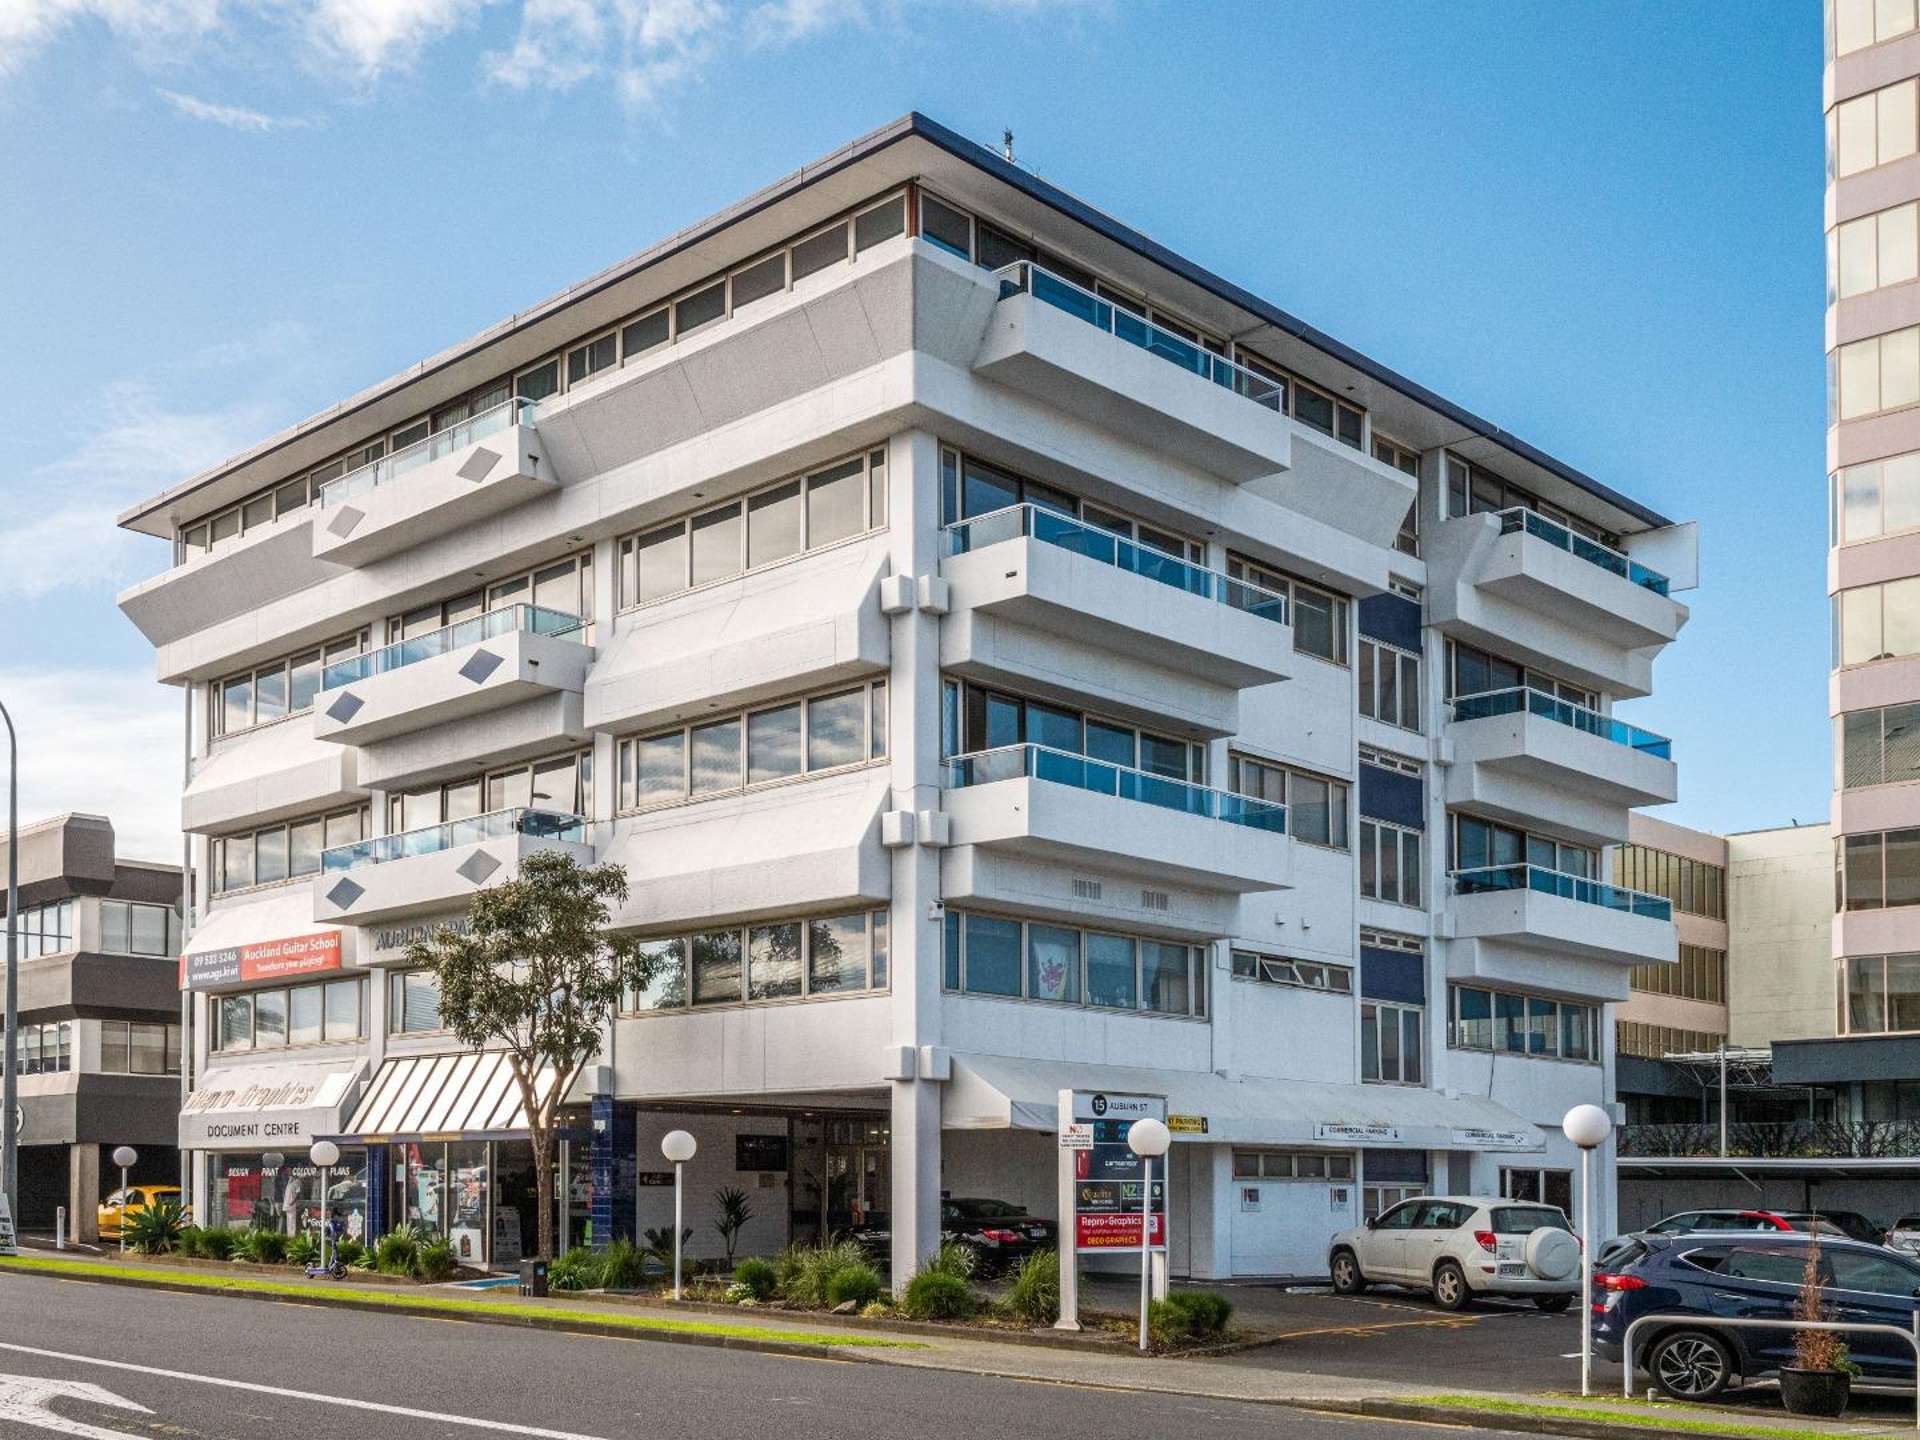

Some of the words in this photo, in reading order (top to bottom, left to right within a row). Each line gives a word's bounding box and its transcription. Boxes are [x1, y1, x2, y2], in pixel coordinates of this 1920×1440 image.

[244, 945, 281, 960] Auckland
[282, 940, 309, 955] Guitar
[310, 934, 338, 951] School
[1094, 1099, 1105, 1112] 15
[1108, 1102, 1138, 1111] AUBURN
[1140, 1103, 1148, 1112] ST
[207, 1123, 259, 1138] DOCUMENT
[263, 1122, 300, 1136] CENTRE
[1329, 1126, 1364, 1134] COMMERCIAL
[228, 1167, 249, 1177] DESIGN
[292, 1167, 318, 1177] COLOUR
